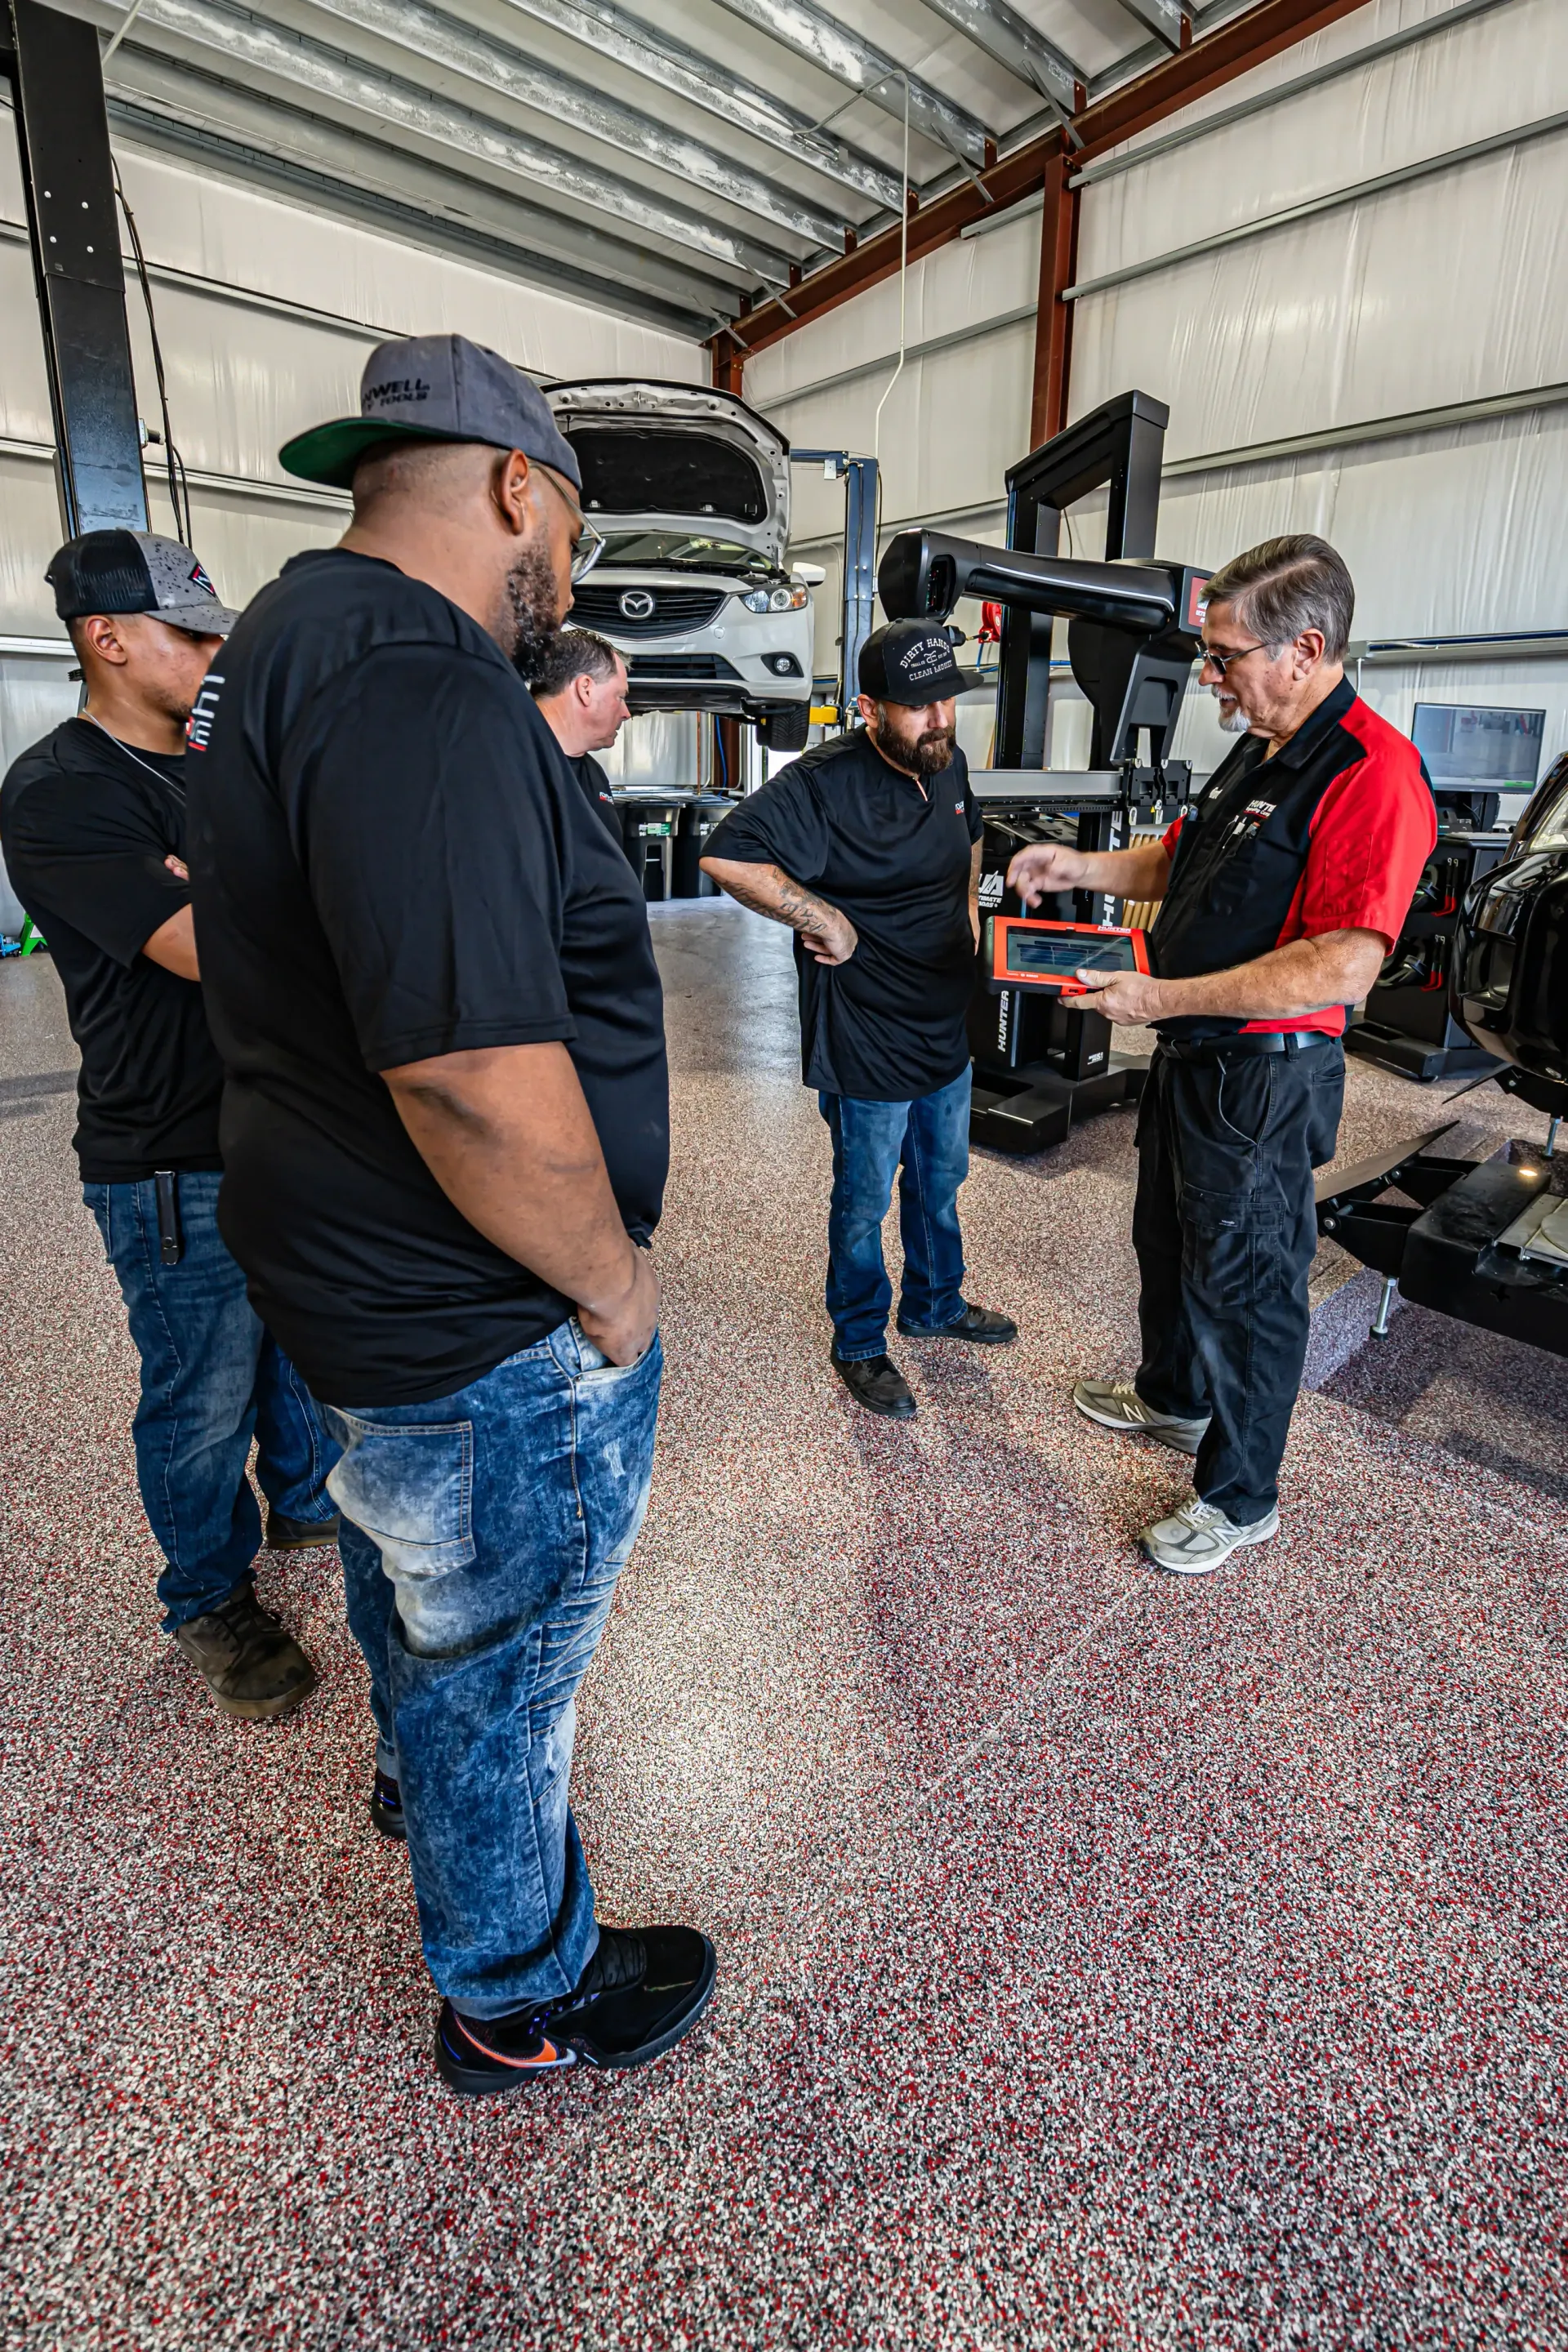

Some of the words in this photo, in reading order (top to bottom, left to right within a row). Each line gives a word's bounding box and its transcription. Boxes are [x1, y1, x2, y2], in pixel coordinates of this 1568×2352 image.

[900, 641, 924, 669] DIRTY
[927, 638, 950, 653] HANDS
[909, 668, 933, 681] CLEAN
[933, 660, 952, 673] MONEY
[998, 990, 1009, 1053] HUNTER
